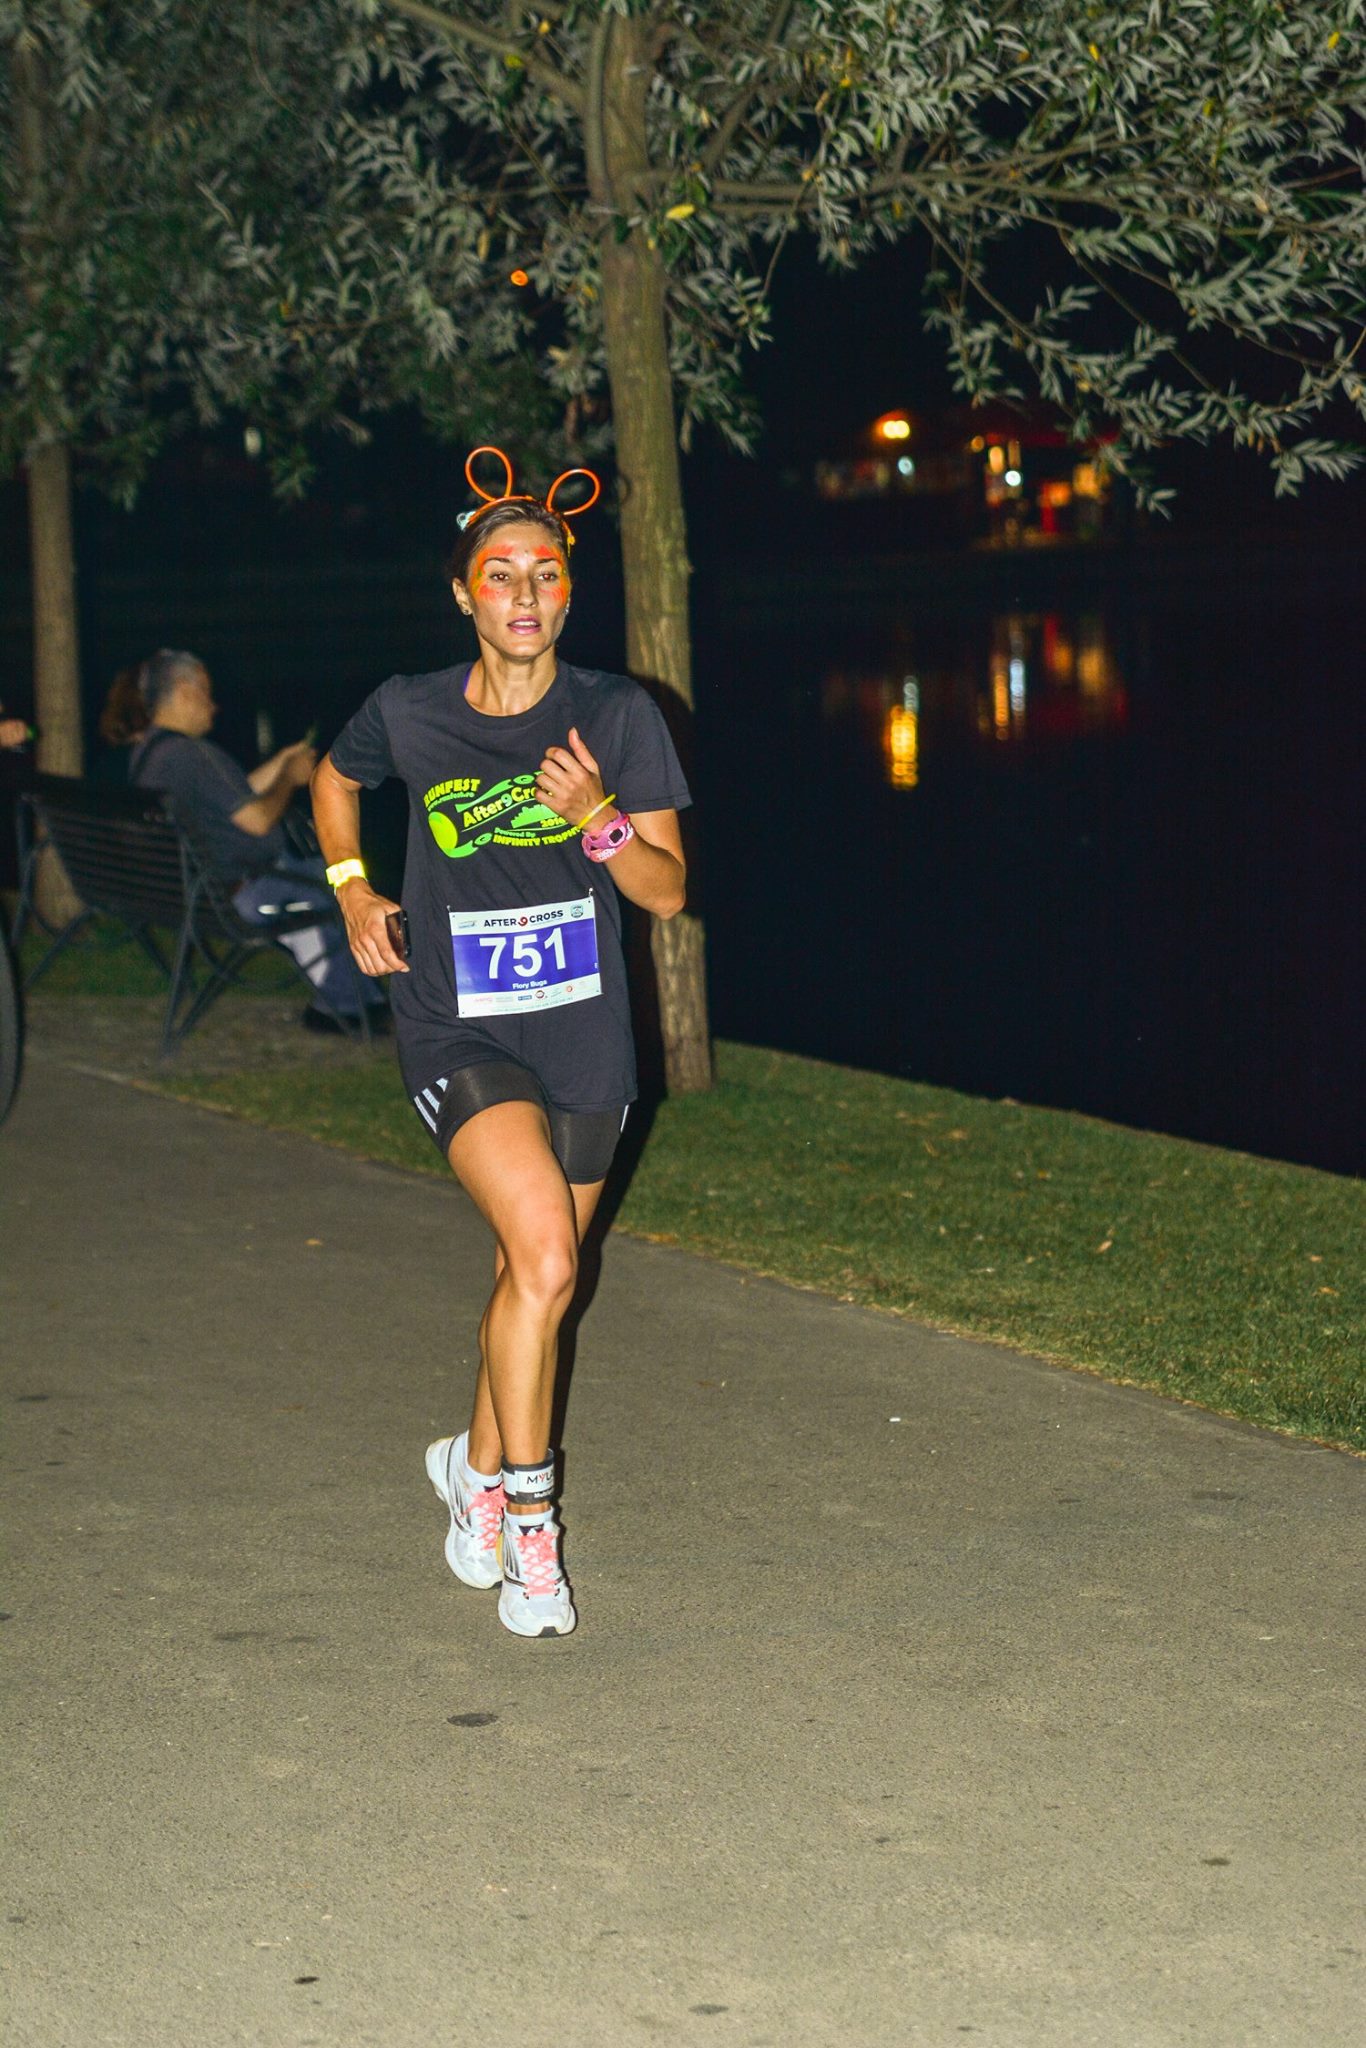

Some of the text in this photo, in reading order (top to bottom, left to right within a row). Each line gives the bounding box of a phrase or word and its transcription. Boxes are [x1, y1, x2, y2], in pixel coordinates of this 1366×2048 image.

[424, 778, 480, 808] RUNFEST
[463, 786, 537, 828] After9Cro
[493, 834, 541, 847] INFINITY
[483, 917, 517, 928] AFTER
[529, 909, 564, 924] CROSS
[479, 927, 566, 980] 751
